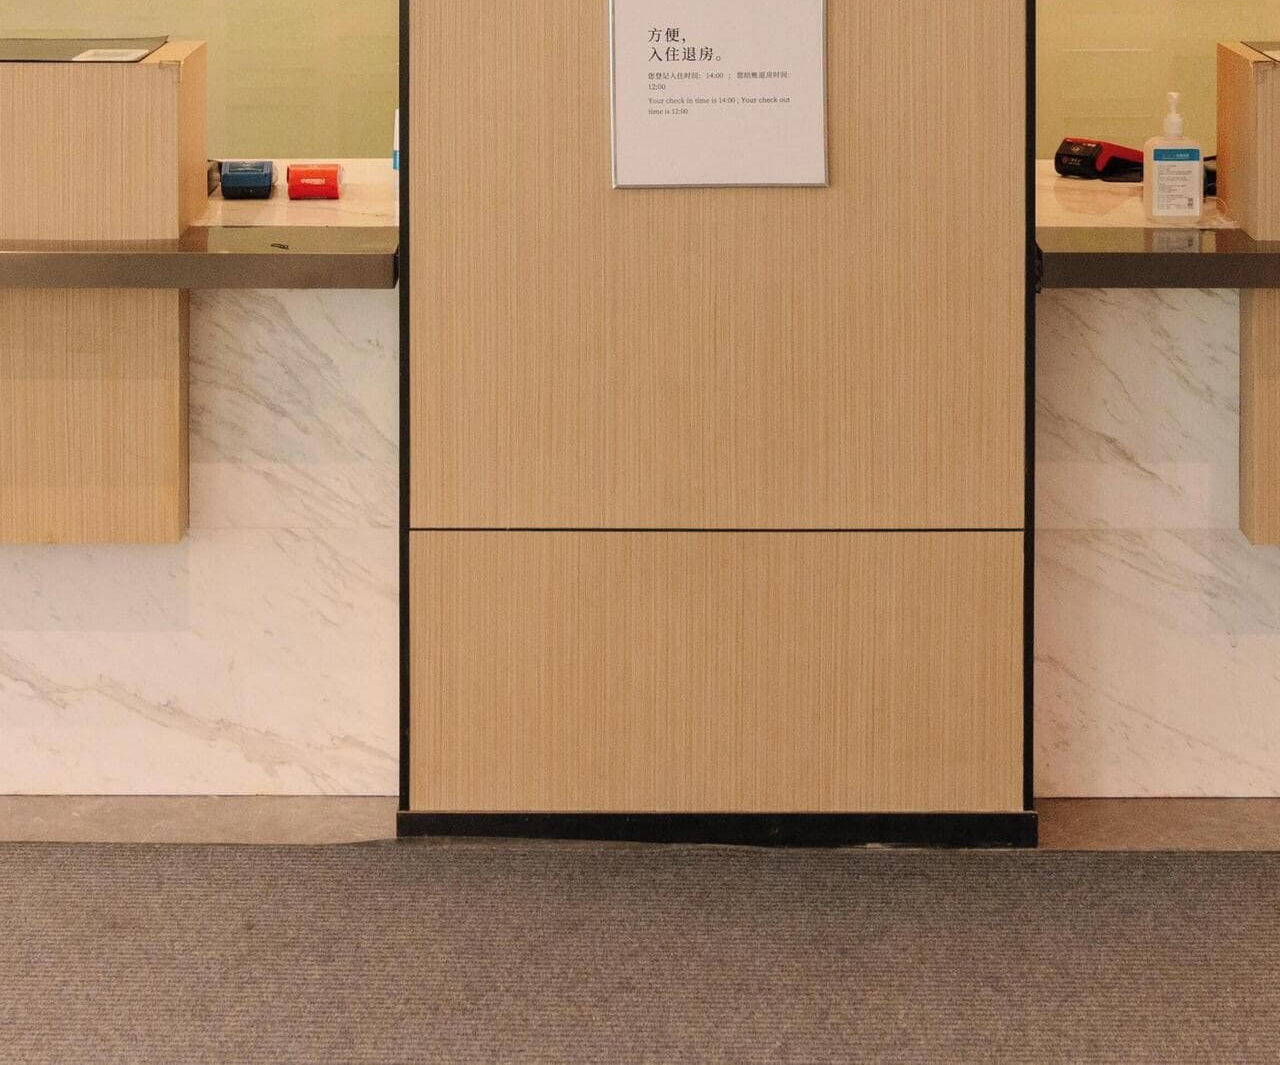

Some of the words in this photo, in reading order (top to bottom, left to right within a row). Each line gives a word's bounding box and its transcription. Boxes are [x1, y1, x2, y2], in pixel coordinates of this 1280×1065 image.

[648, 27, 687, 44] 方便，
[648, 46, 722, 62] 入住退房。
